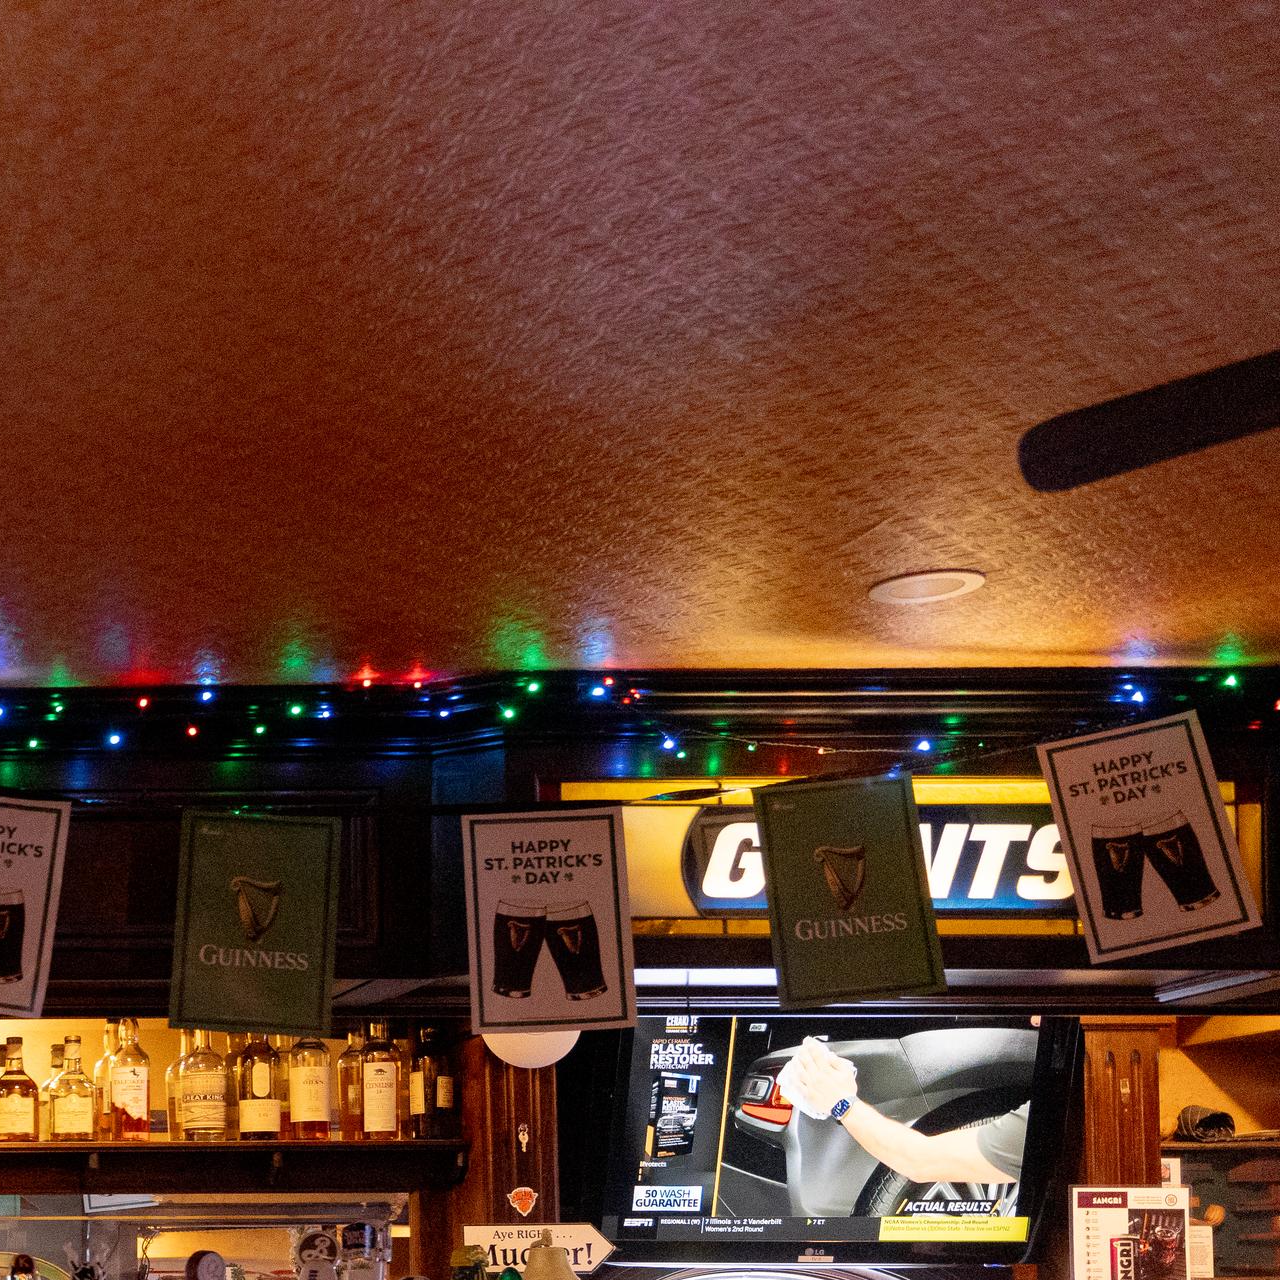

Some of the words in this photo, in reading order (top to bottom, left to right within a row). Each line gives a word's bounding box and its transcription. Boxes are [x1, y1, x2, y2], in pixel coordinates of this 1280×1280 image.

[1093, 751, 1154, 776] HAPPY
[1070, 782, 1095, 797] ST.
[1099, 760, 1188, 791] PATRICK'S
[1114, 786, 1147, 804] DAY
[511, 839, 571, 854] HAPPY
[485, 858, 509, 871] ST.
[513, 853, 603, 870] PATRICK'S
[526, 871, 561, 885] DAY
[794, 913, 907, 941] GUINNESS
[199, 944, 309, 971] GUINNESS
[650, 1043, 704, 1056] PLASTIC
[650, 1054, 714, 1066] RESTORER
[645, 1189, 657, 1198] 50
[659, 1189, 690, 1198] WASH
[635, 1198, 699, 1208] GUARANTEE
[904, 1202, 944, 1212] ACTUAL
[948, 1201, 991, 1212] RESULTS
[623, 1218, 653, 1226] ESPN
[749, 1217, 782, 1225] Vanderbilt
[493, 1230, 515, 1243] Aye
